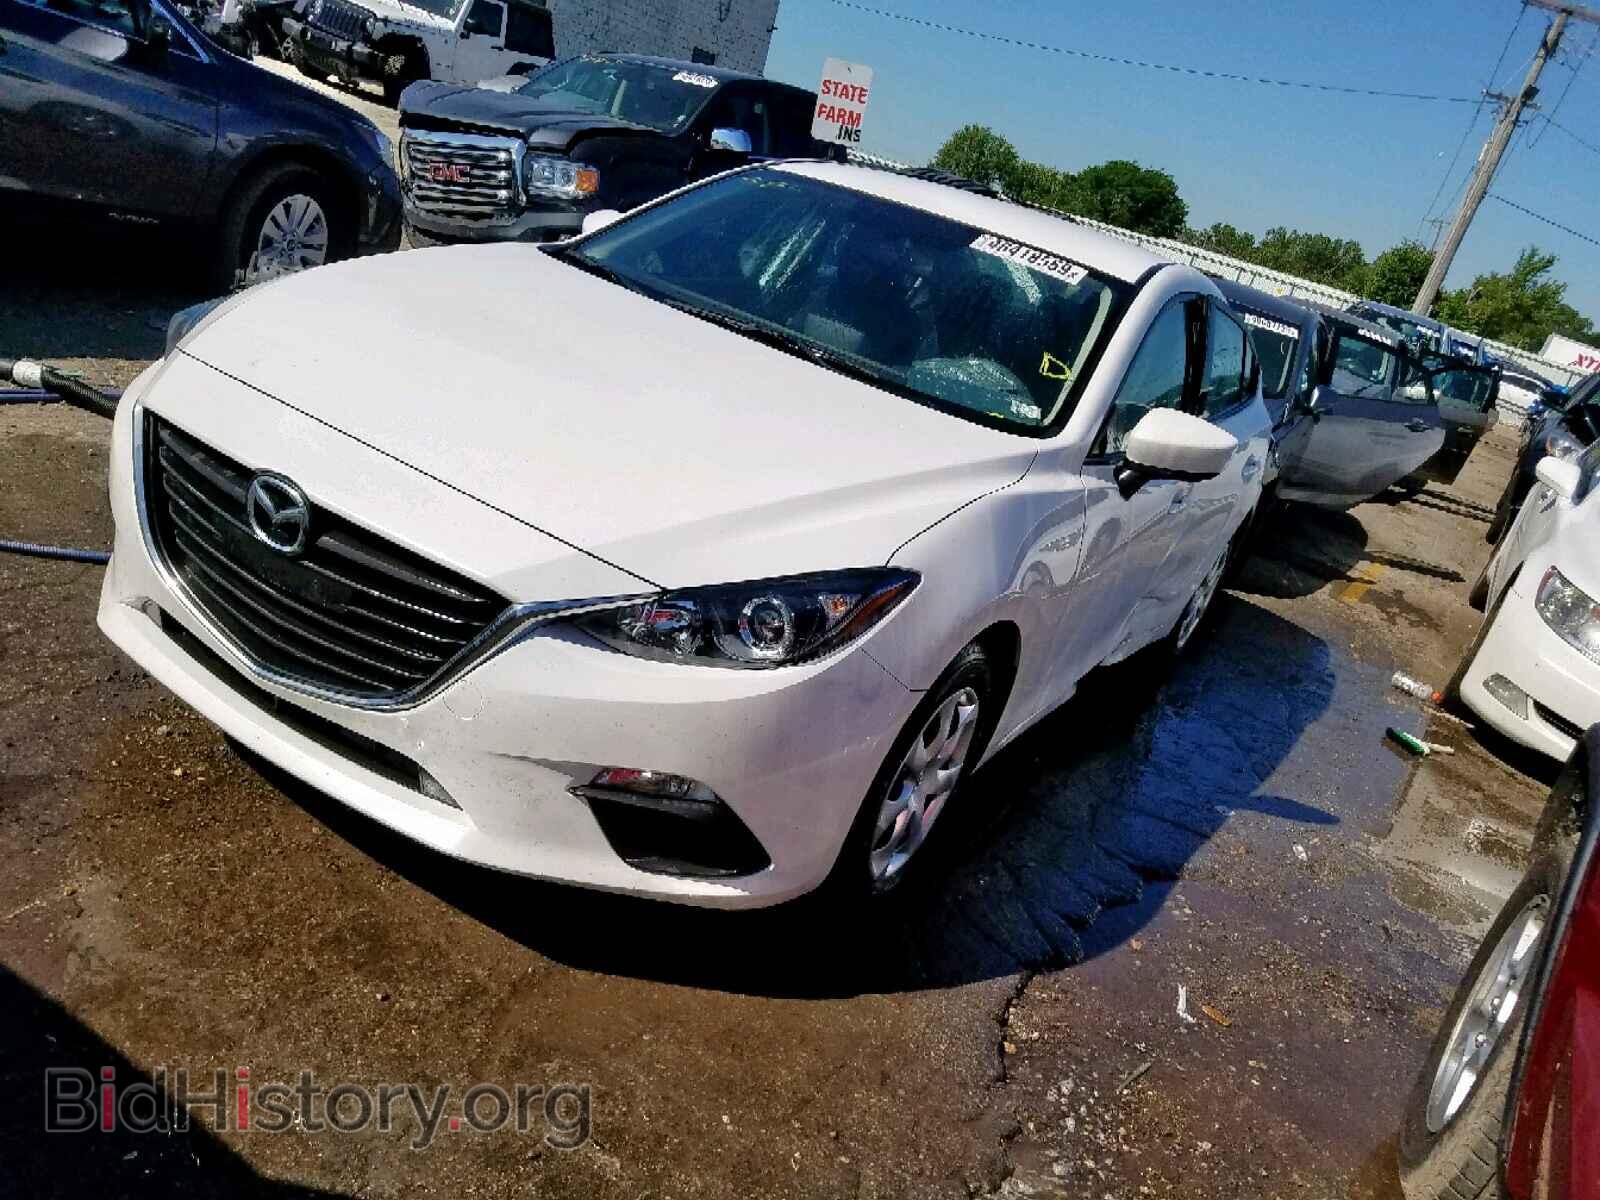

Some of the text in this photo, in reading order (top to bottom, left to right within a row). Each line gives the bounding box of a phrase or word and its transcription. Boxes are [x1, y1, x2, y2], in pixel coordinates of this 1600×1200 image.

[821, 79, 868, 104] STATE
[817, 103, 862, 128] FARM
[837, 124, 862, 142] INS
[428, 162, 470, 182] GMC
